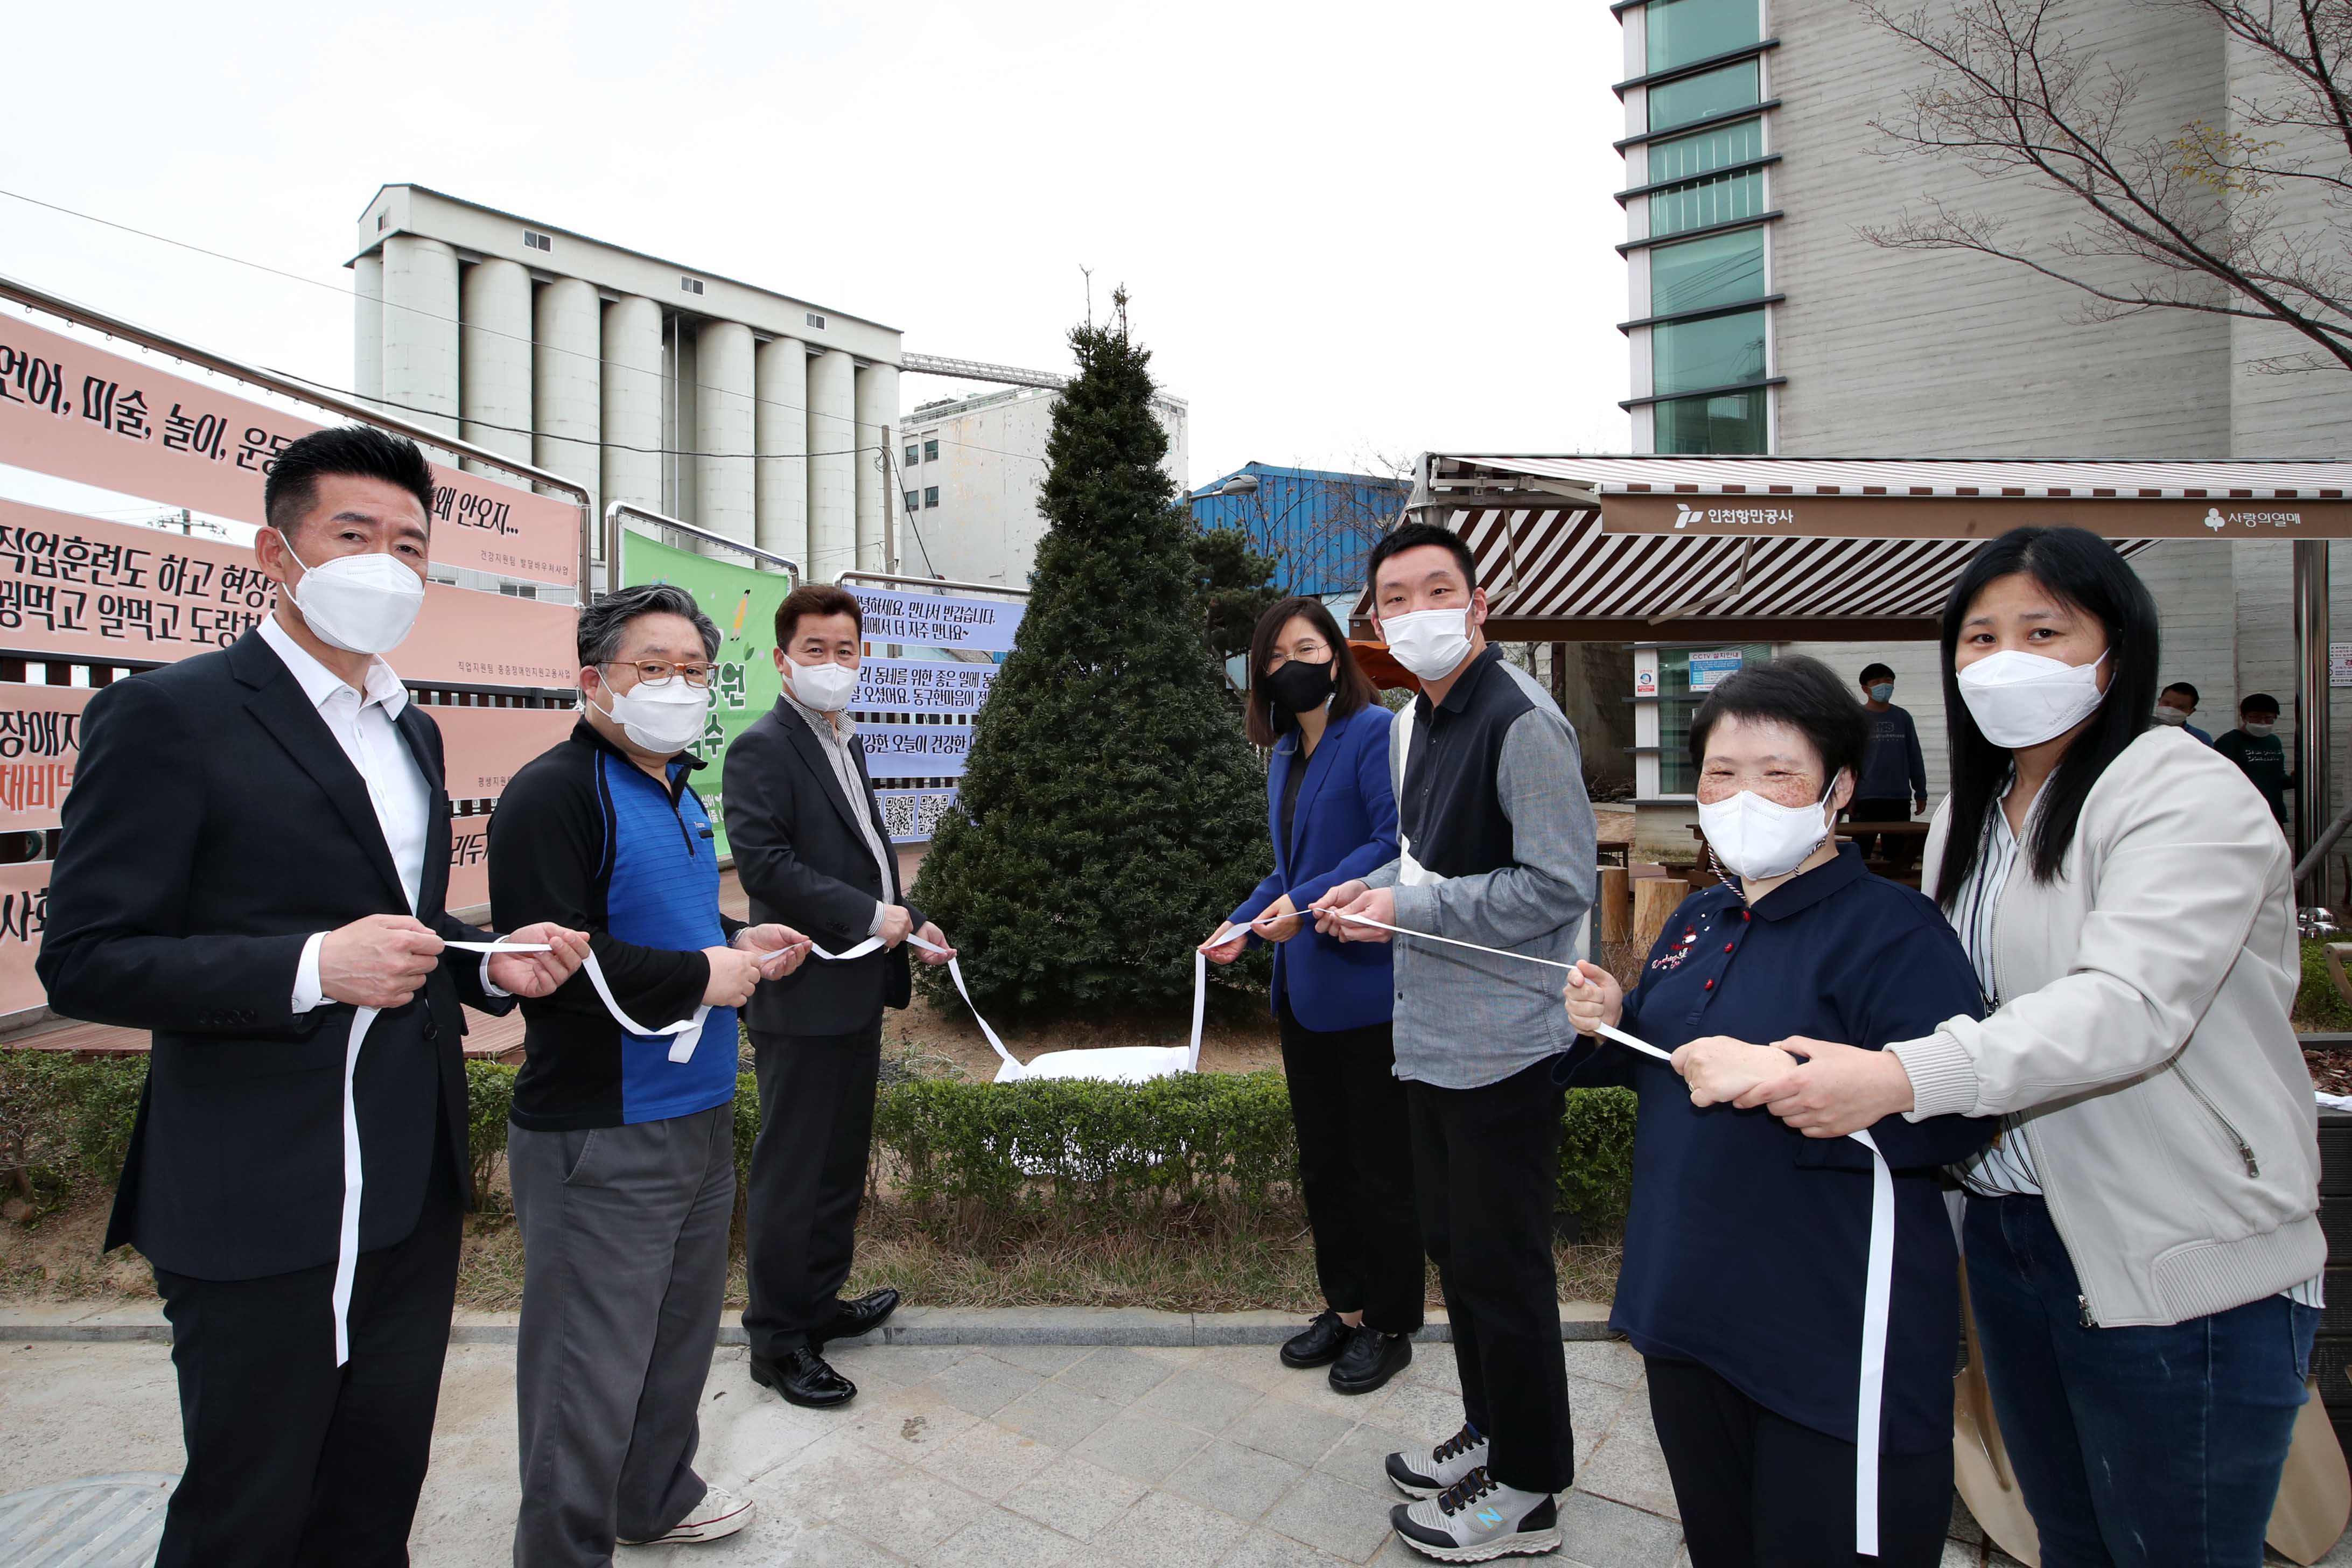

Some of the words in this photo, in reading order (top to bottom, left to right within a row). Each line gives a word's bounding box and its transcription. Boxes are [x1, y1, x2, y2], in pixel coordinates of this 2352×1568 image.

[83, 375, 152, 439] 미술,
[163, 403, 227, 460] 놀이,
[457, 493, 519, 535] 안오지...
[1707, 509, 1794, 525] 인천항만공사
[2228, 512, 2301, 528] 사랑의열매
[159, 554, 214, 597] 하고
[98, 594, 182, 641] 알먹고
[908, 601, 941, 621] 만나서
[943, 605, 996, 625] 반갑습니다.
[894, 620, 905, 637] 더
[908, 621, 929, 639] 자주
[932, 623, 969, 641] 만나요~
[874, 667, 908, 686] 동네를
[911, 668, 933, 687] 위한
[935, 670, 957, 688] 좋은
[959, 671, 979, 689] 일에
[865, 686, 911, 705] 오셨어요.
[913, 688, 974, 707] 동구한마음이
[892, 734, 927, 754] 오늘이
[931, 735, 967, 754] 건강한
[1474, 1507, 1504, 1530] N
